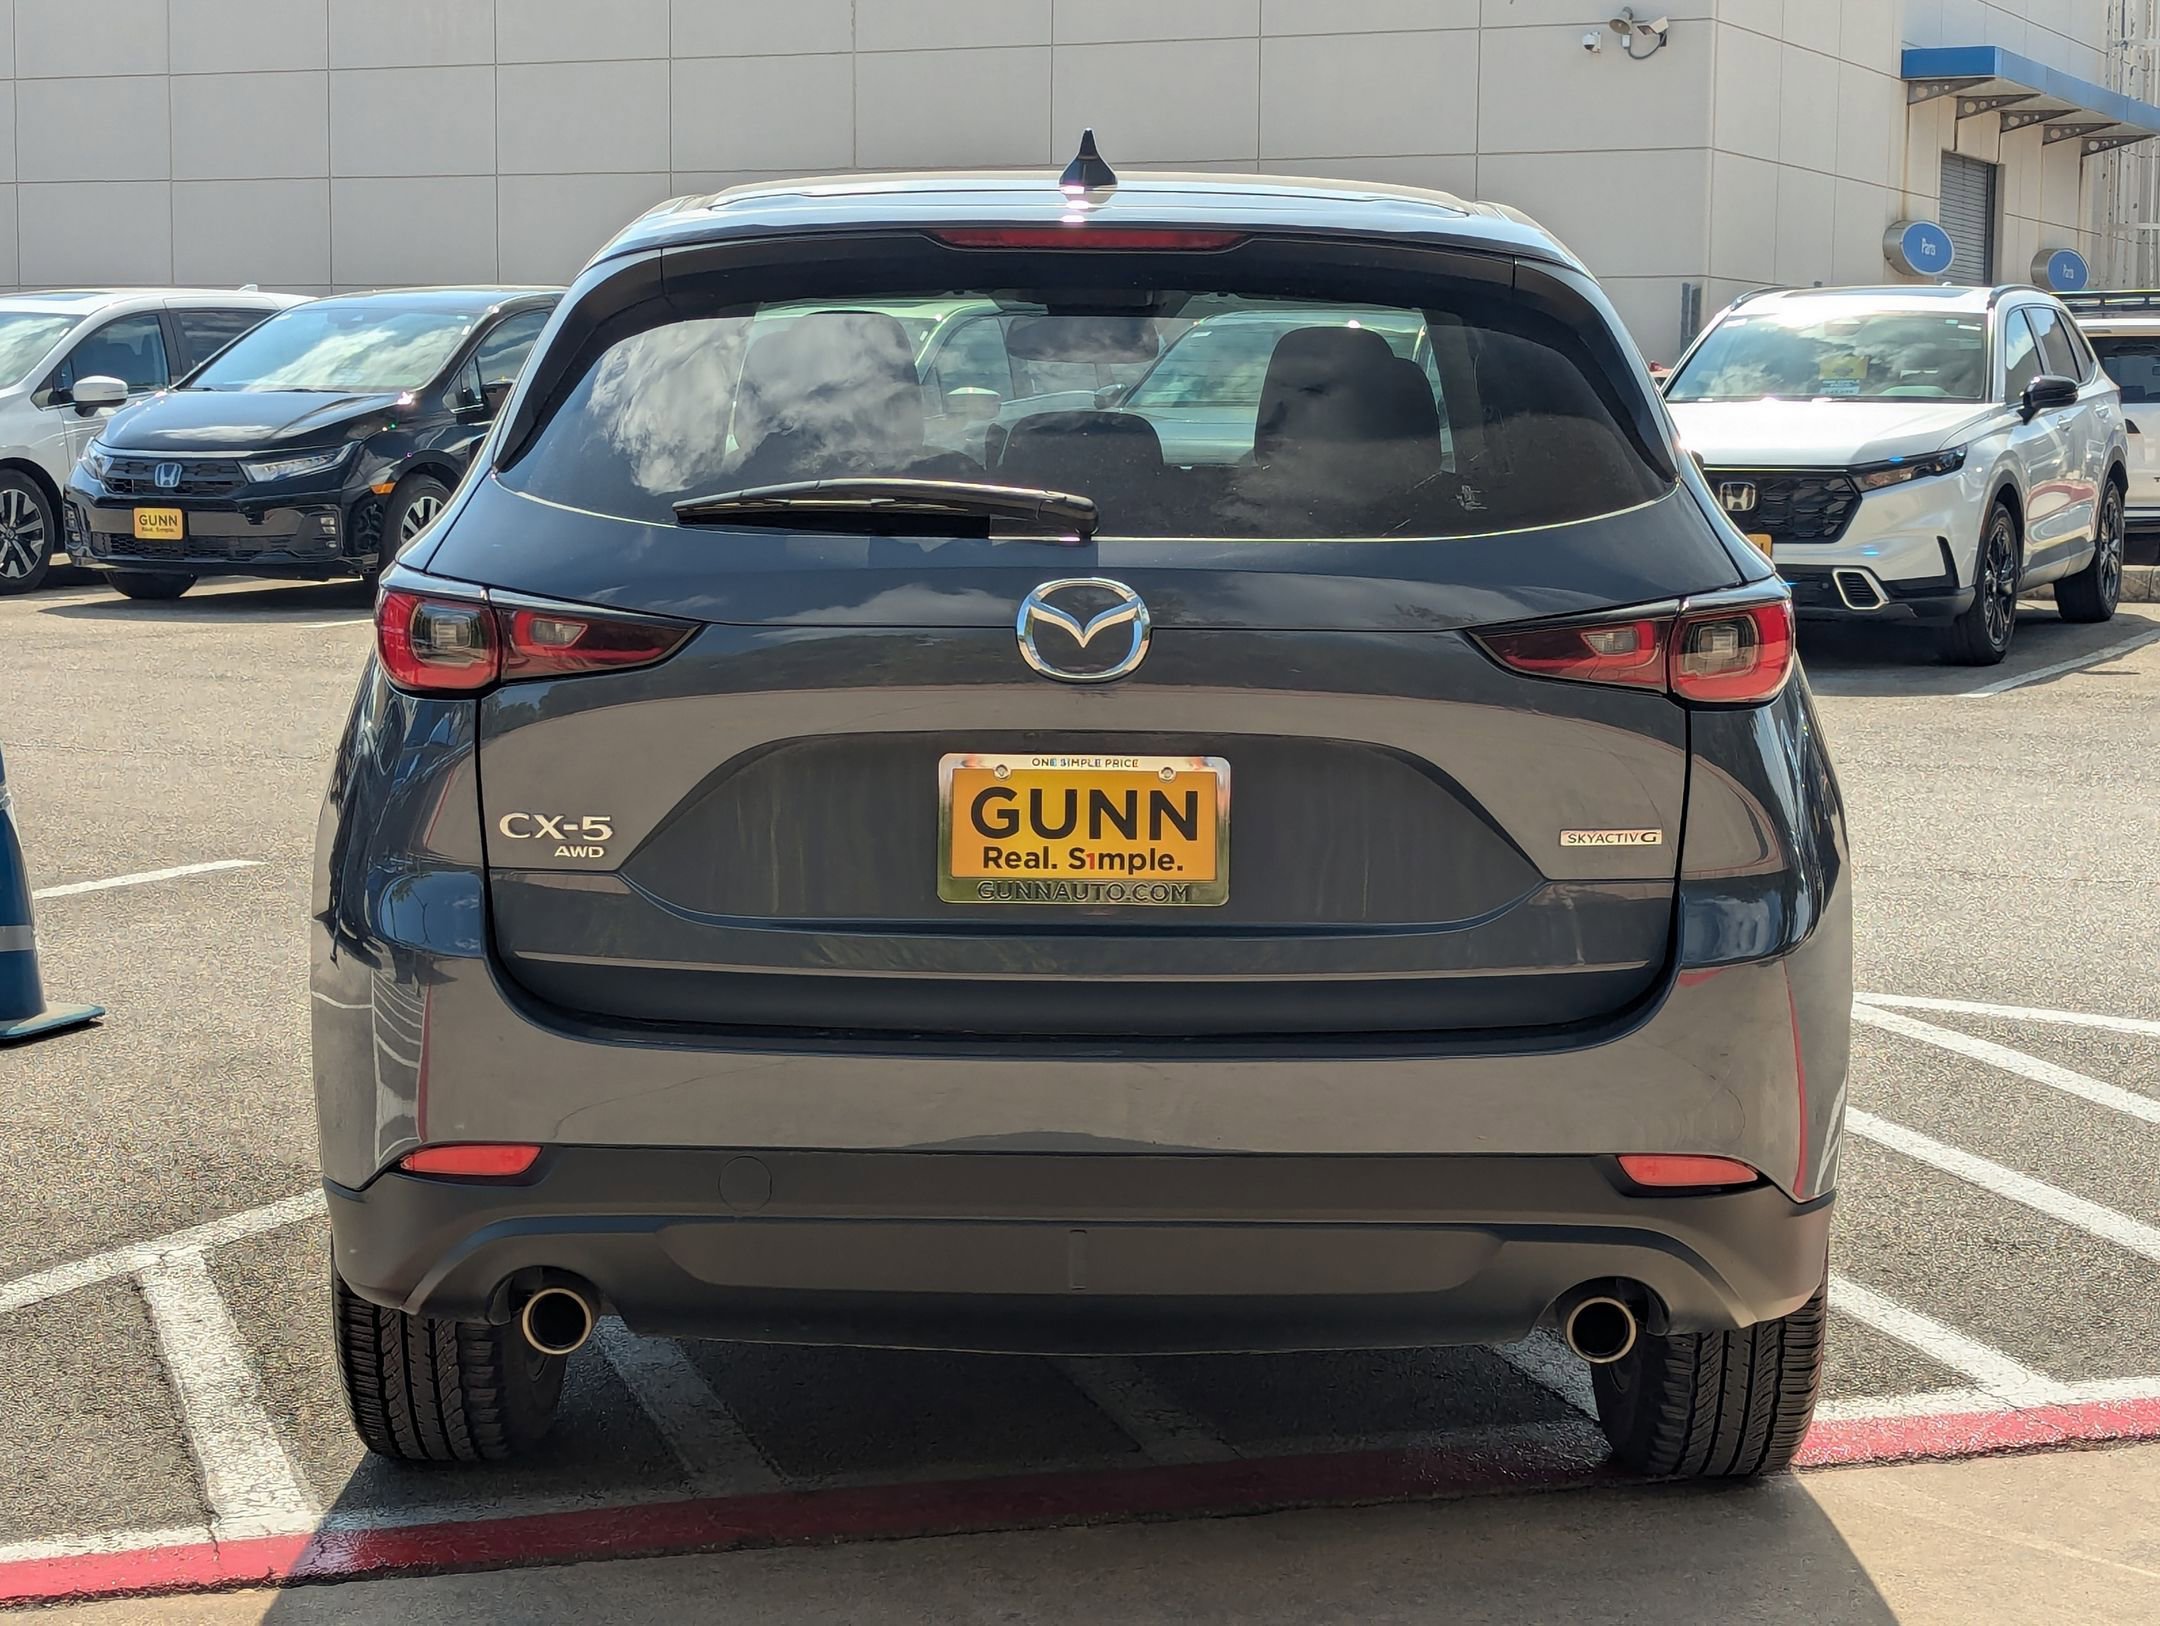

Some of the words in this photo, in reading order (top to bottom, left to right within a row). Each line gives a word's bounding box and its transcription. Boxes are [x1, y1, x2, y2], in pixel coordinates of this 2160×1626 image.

[139, 514, 178, 526] GUNN
[1031, 757, 1057, 767] ONE
[1060, 758, 1102, 768] SIMPLE
[1104, 758, 1139, 768] PRICE
[970, 786, 1199, 841] GUNN
[499, 812, 614, 841] CX-5
[554, 845, 605, 858] AWD
[983, 846, 1058, 870] Real.
[976, 880, 1191, 902] GUNNAUTO.COM
